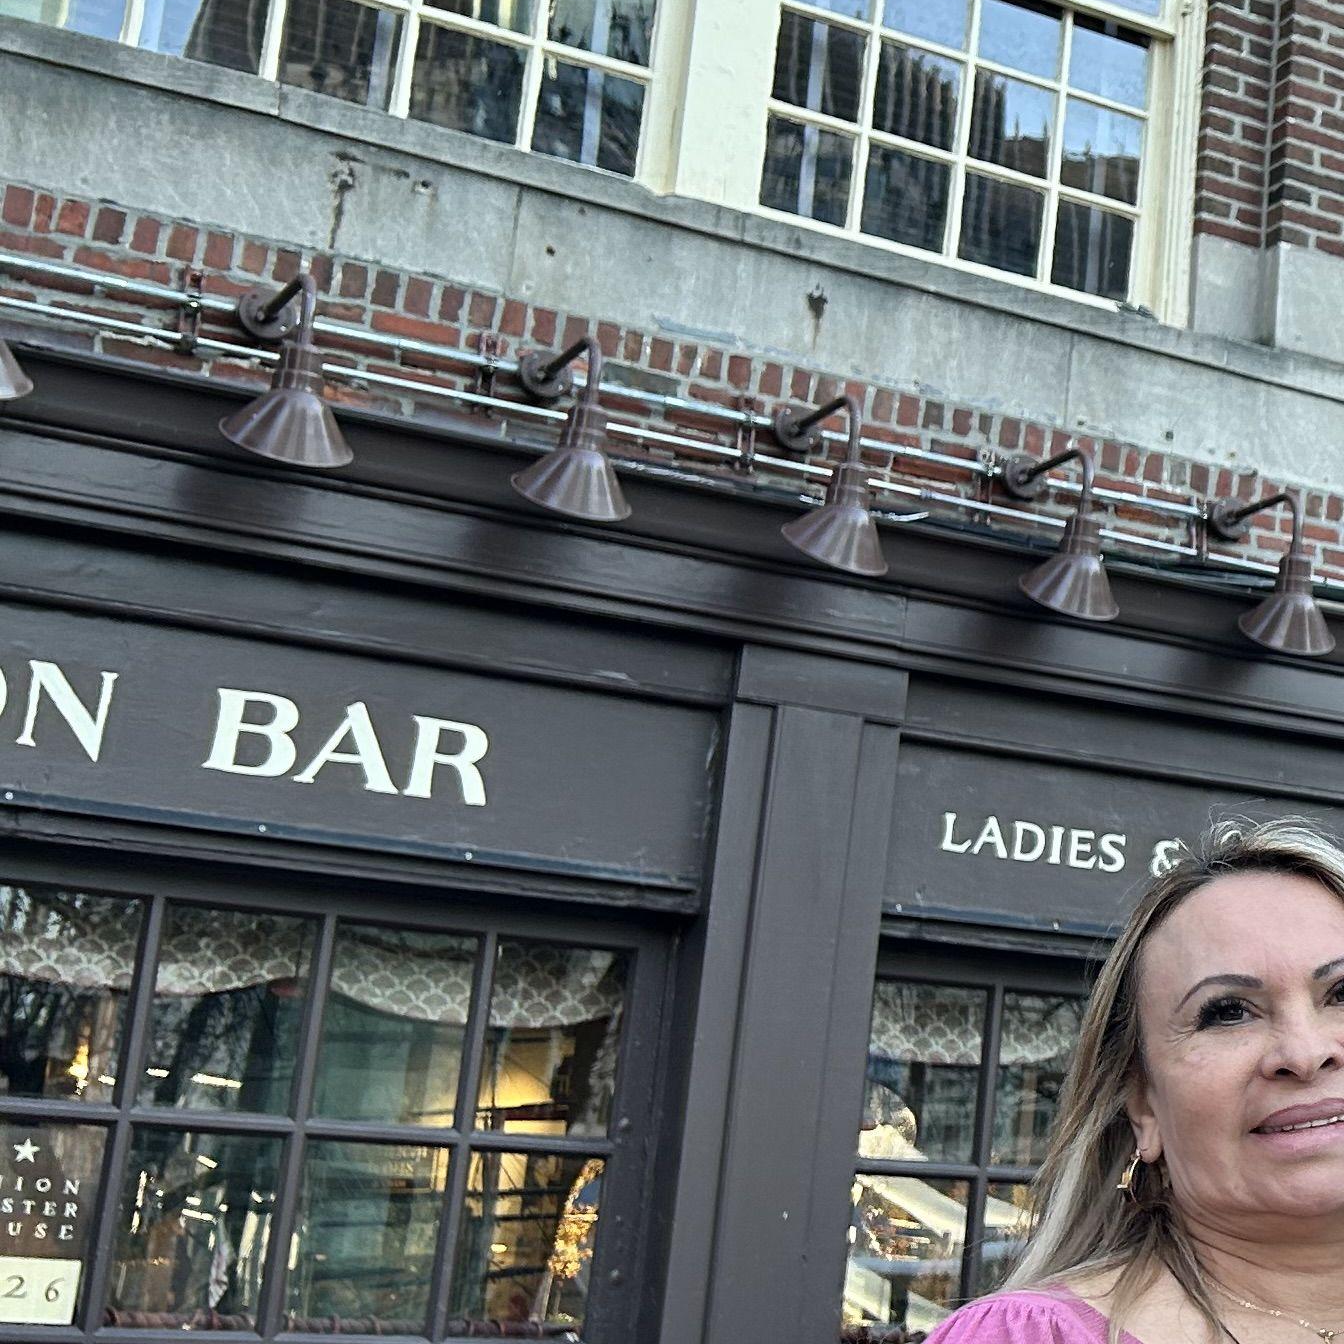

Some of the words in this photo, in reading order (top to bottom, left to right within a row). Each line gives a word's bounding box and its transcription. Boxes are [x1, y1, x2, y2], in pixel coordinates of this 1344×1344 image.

[0, 659, 119, 763] N
[202, 687, 487, 806] BAR
[941, 812, 1126, 873] LADIES
[0, 1174, 80, 1196] ION
[1, 1197, 78, 1218] STER
[3, 1274, 65, 1303] 26
